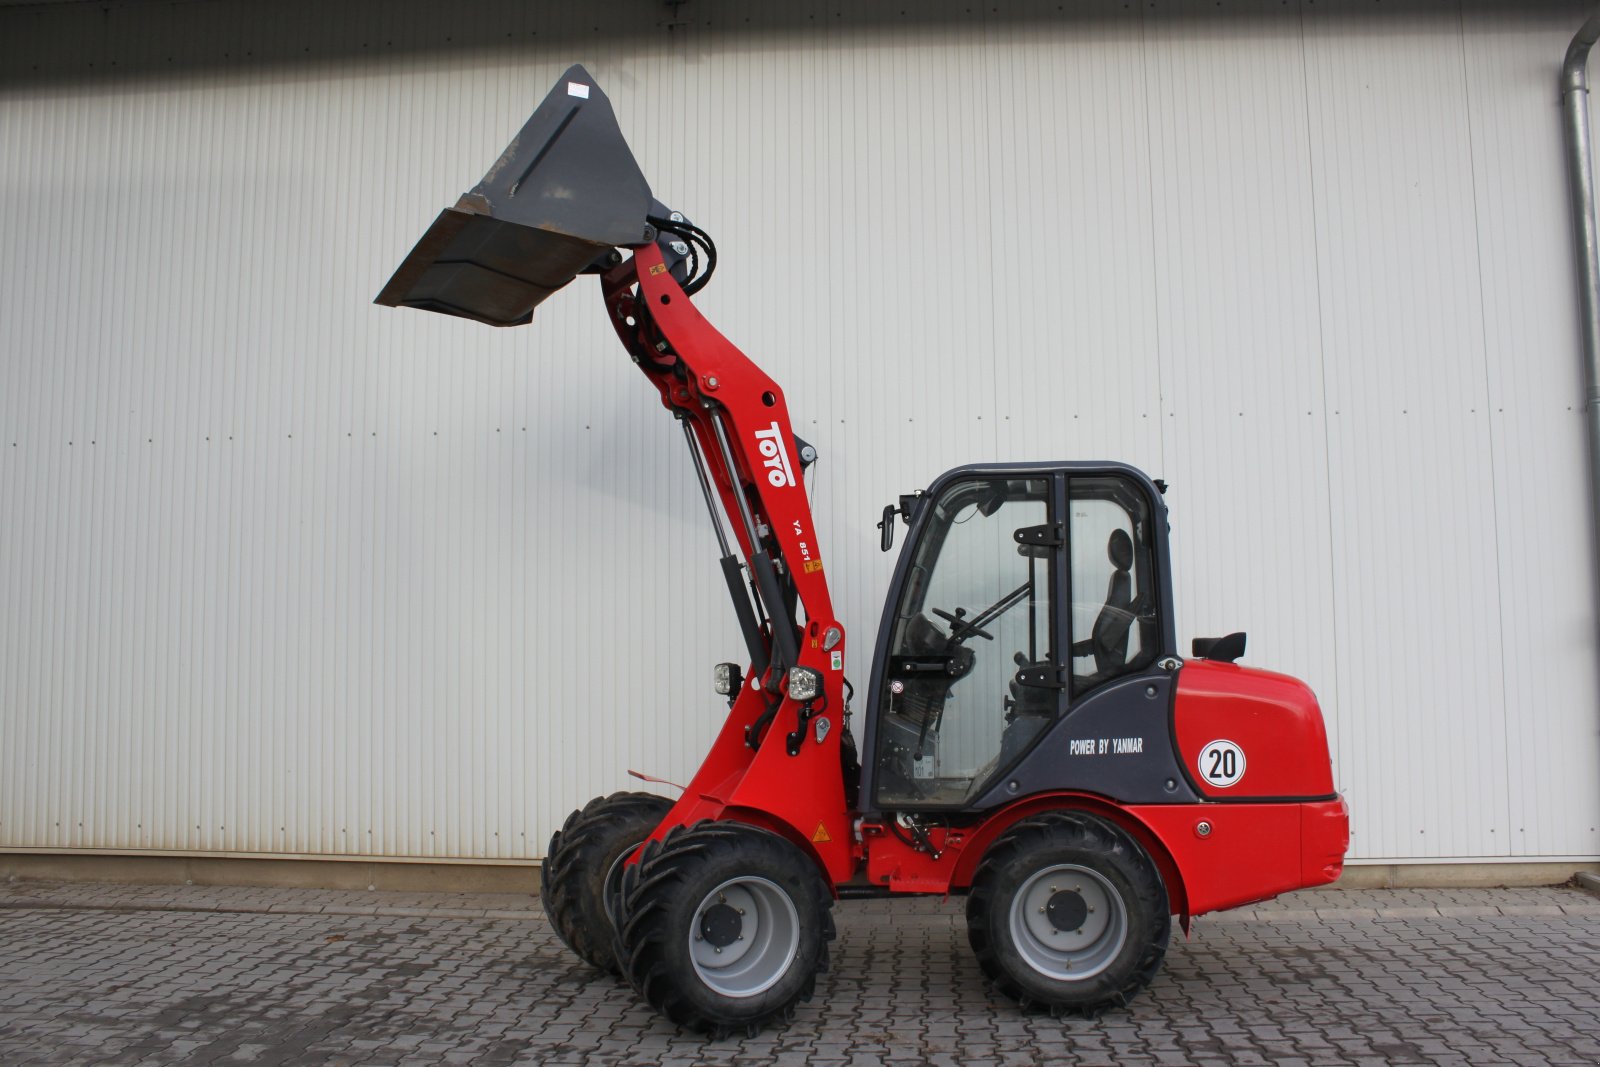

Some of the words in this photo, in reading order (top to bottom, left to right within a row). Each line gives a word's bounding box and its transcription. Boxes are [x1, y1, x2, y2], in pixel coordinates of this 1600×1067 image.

[755, 421, 796, 488] TOYO
[793, 520, 803, 536] YA
[799, 542, 811, 561] 851
[1070, 739, 1095, 755] POWER
[1099, 738, 1110, 754] BY
[1112, 737, 1143, 754] YANMAR
[1209, 749, 1236, 778] 20
